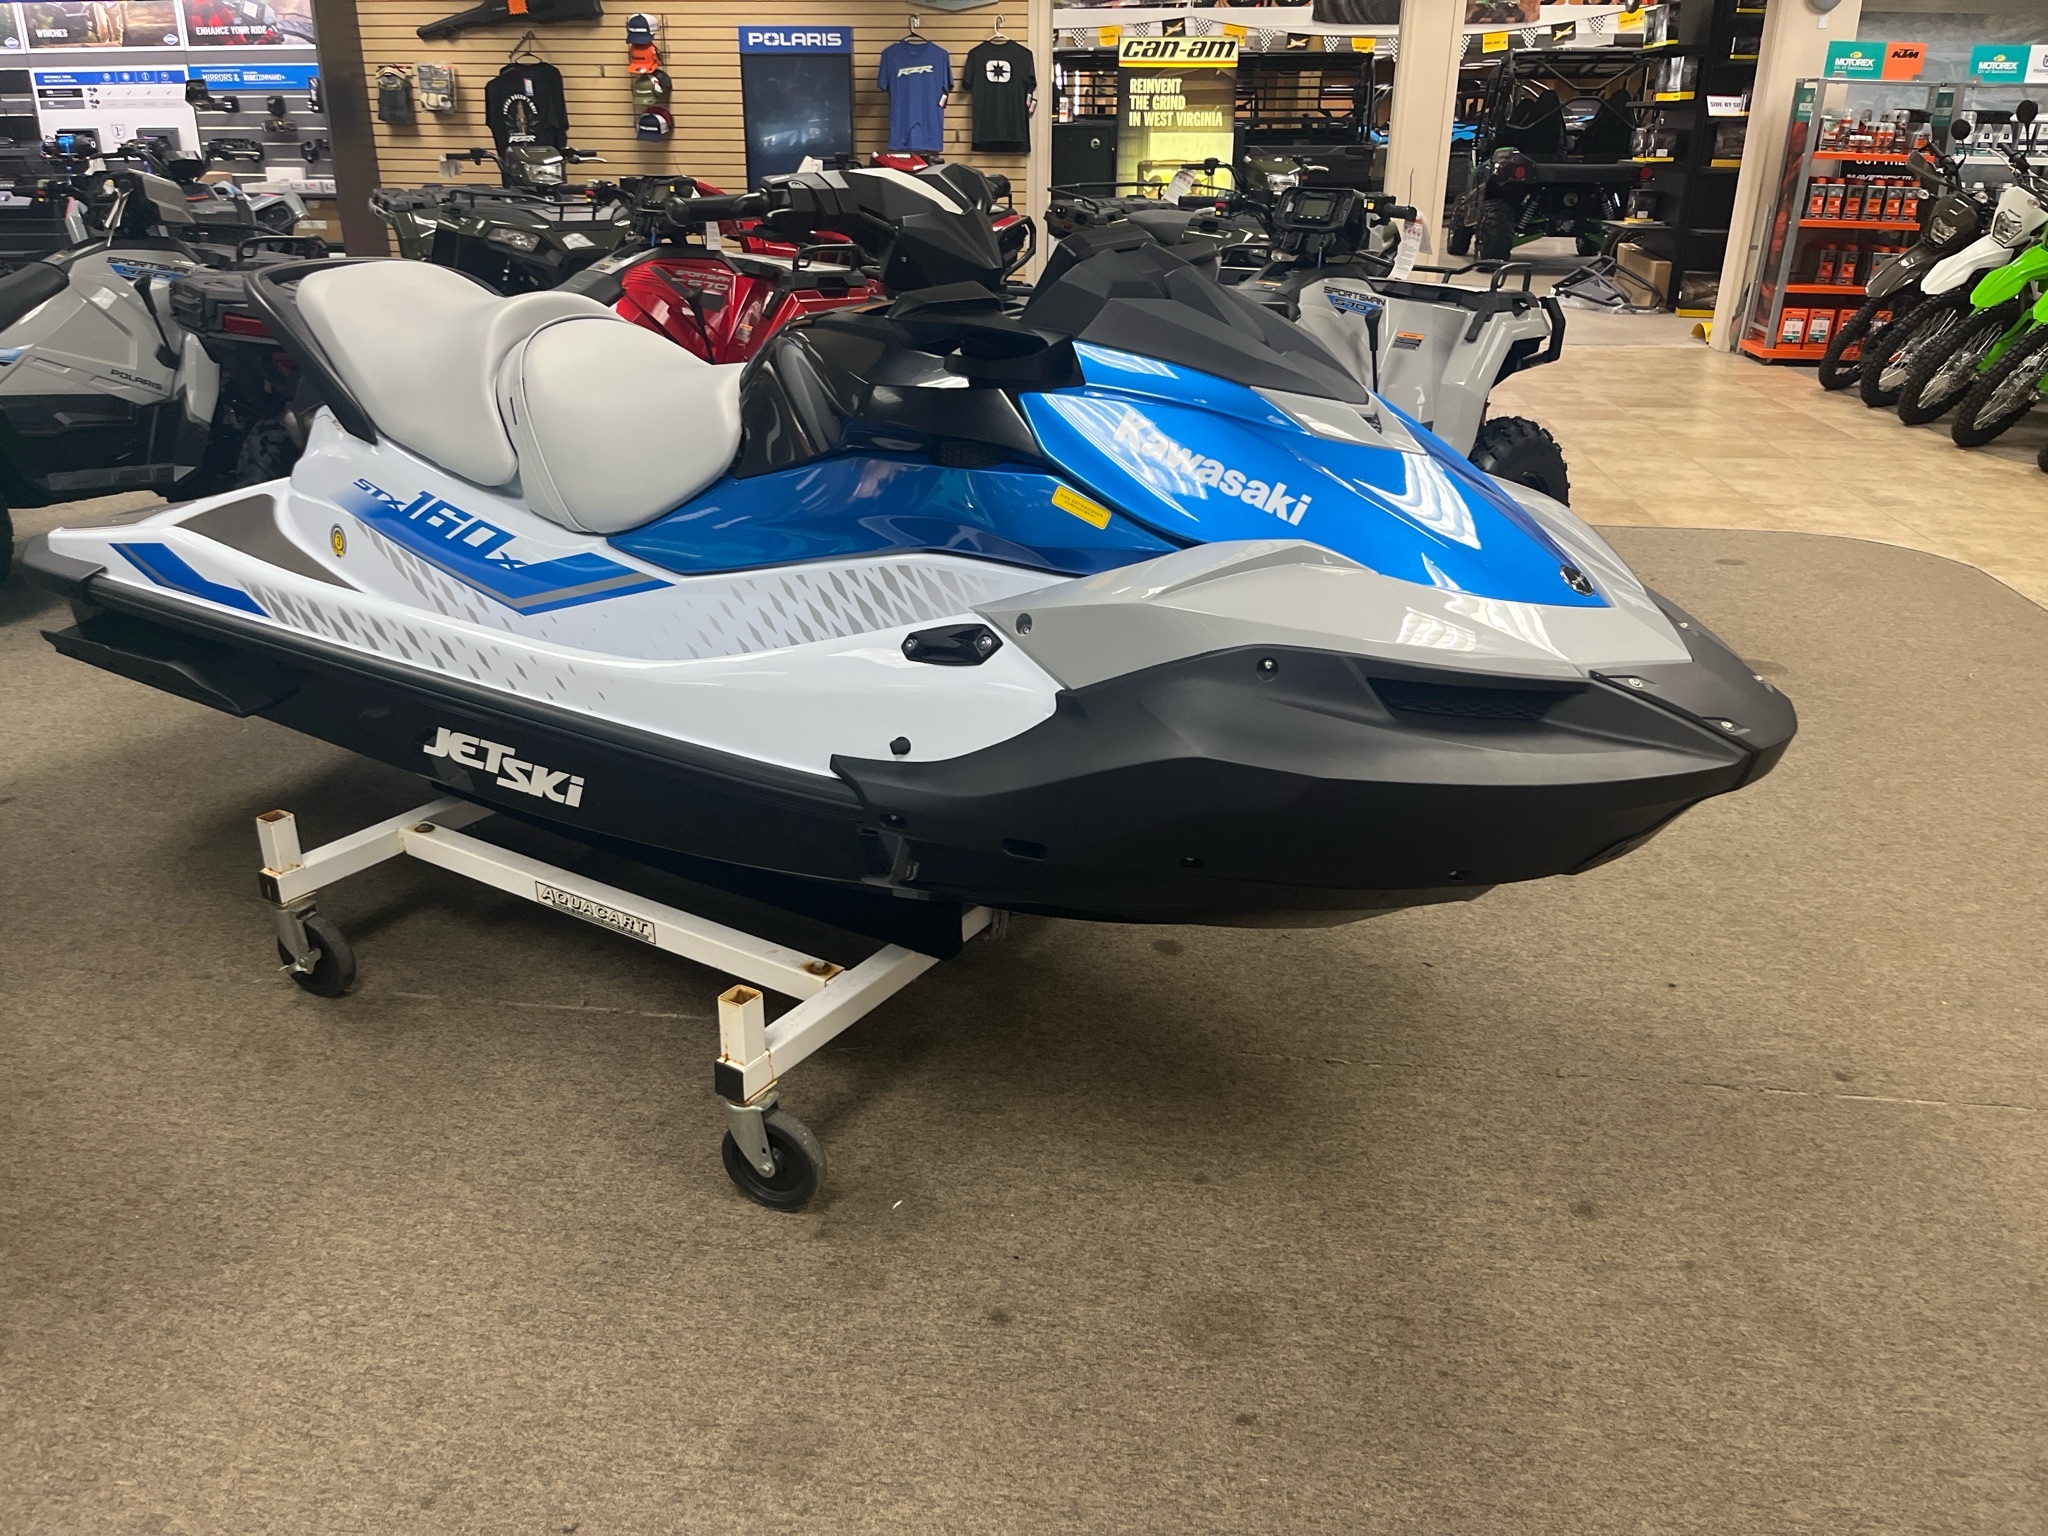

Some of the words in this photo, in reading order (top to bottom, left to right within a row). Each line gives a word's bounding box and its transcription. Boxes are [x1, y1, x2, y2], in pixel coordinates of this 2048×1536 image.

[36, 29, 68, 37] WINCHES
[195, 26, 229, 35] ENHANCE
[230, 26, 250, 35] YOUR
[251, 25, 267, 34] RIDE
[748, 32, 842, 46] POLARIS
[1892, 49, 1919, 58] KTM
[1835, 58, 1875, 66] MOTOREX
[202, 73, 232, 82] MIRRORS
[1130, 79, 1182, 94] REINVENT
[1129, 95, 1149, 110] THE
[1152, 95, 1186, 110] GRIND
[1129, 112, 1141, 127] IN
[1144, 112, 1173, 127] WEST
[1177, 112, 1223, 127] VIRGINIA
[675, 269, 731, 282] SPORTSMAN
[1323, 286, 1386, 306] SPORTSMAN
[111, 369, 162, 390] POLARIS
[1113, 410, 1313, 526] Kawasaki
[353, 478, 408, 512] STX
[423, 726, 516, 774] JET
[541, 886, 648, 934] AQUACART
